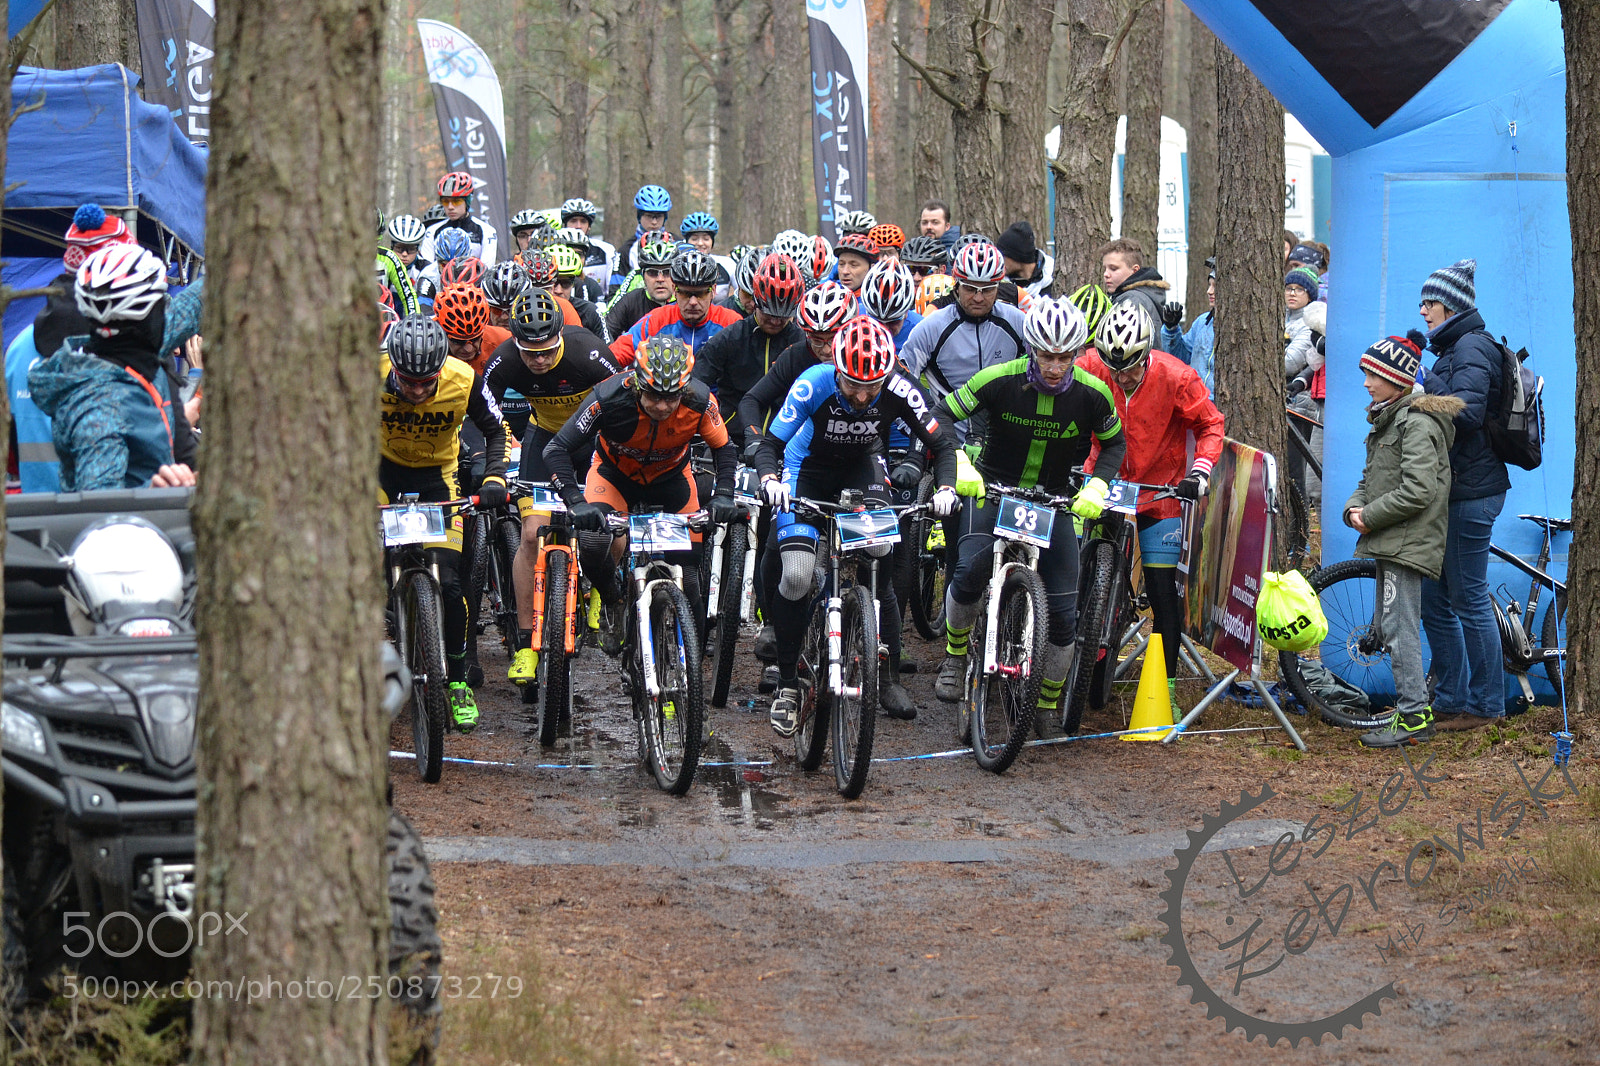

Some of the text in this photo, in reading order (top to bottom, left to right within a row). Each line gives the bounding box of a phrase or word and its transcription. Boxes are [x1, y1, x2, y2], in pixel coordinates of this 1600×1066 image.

[599, 357, 619, 374] RENA
[1369, 339, 1421, 377] UNTE
[484, 356, 502, 382] NAULT
[386, 423, 453, 434] YCLING
[1001, 411, 1061, 430] dimension
[1033, 428, 1059, 439] data
[400, 512, 428, 534] 90
[860, 513, 875, 534] 3
[1014, 506, 1038, 531] 93
